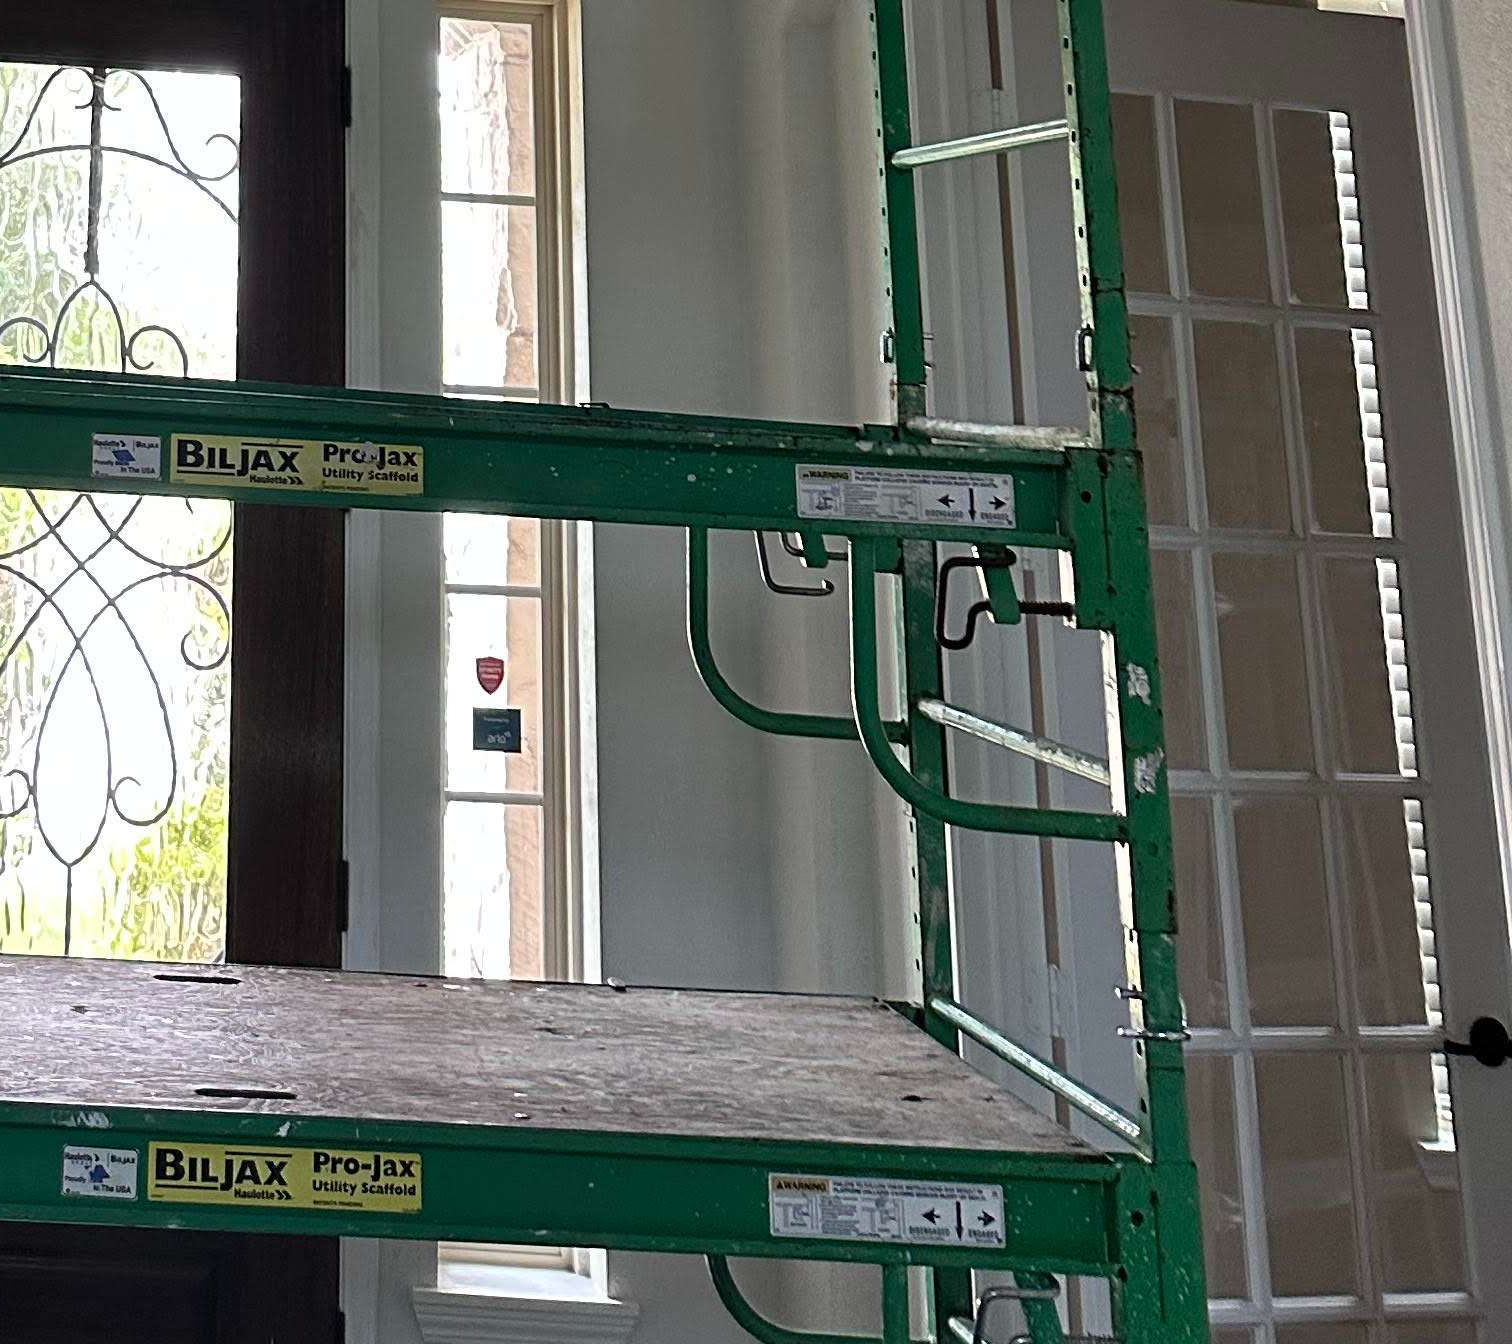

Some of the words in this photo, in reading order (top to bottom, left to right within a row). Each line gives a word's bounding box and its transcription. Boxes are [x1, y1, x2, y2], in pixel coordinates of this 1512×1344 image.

[322, 467, 364, 482] Utility
[367, 470, 419, 483] Scaffold
[312, 1152, 416, 1179] Pro-Jax
[116, 1185, 132, 1194] USA
[311, 1178, 358, 1195] Utility
[361, 1182, 417, 1197] Scaffold
[784, 1180, 827, 1192] WARNING
[233, 1188, 276, 1201] Haulette
